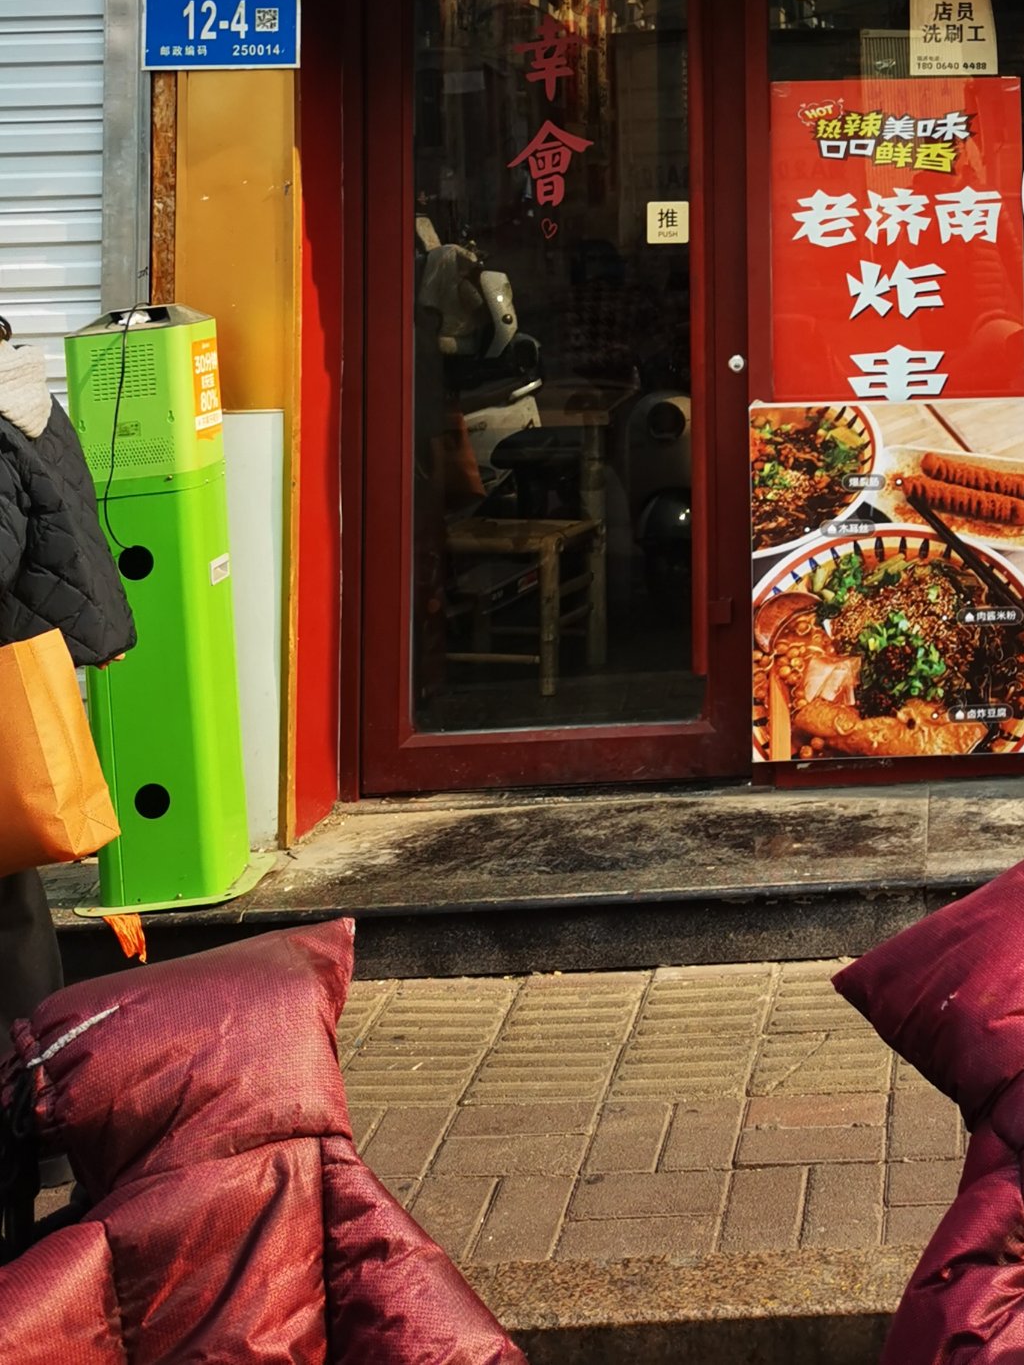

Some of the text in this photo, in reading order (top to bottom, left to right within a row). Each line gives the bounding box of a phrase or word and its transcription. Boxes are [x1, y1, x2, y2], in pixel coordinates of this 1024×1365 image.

[183, 0, 248, 40] 12-4
[933, 1, 974, 21] 店员
[922, 24, 985, 43] 洗刷工
[160, 44, 280, 56] 邮政编码 250014
[805, 104, 834, 119] HOT
[816, 111, 970, 141] 热辣美味
[658, 209, 678, 228] 推
[792, 187, 1001, 247] 老济南
[846, 260, 946, 319] 炸
